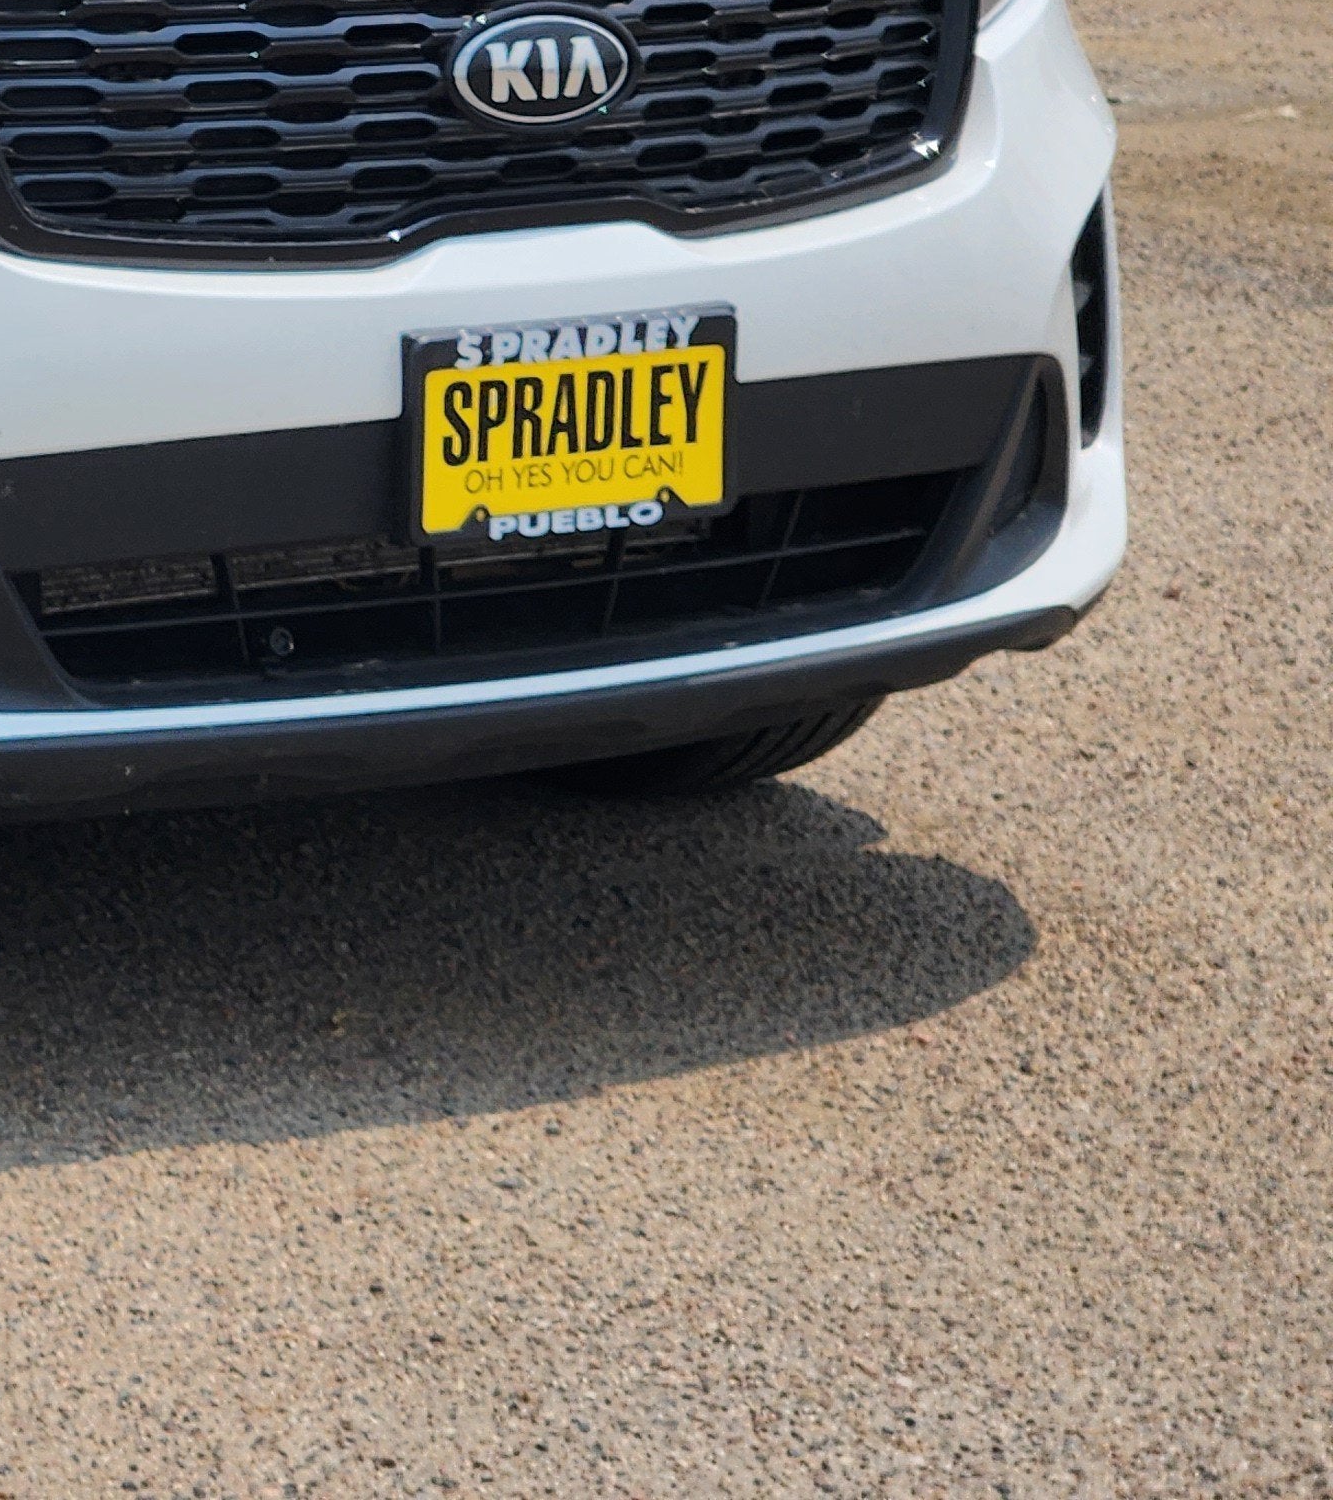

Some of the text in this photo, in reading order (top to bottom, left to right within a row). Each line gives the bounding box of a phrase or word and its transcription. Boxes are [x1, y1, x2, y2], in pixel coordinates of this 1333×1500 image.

[484, 35, 608, 103] KIA
[454, 313, 700, 370] SPRADLEY
[442, 360, 709, 467] SPRADLEY
[464, 450, 684, 495] OH YES YOU CAN!
[488, 500, 665, 542] PUEBLO
